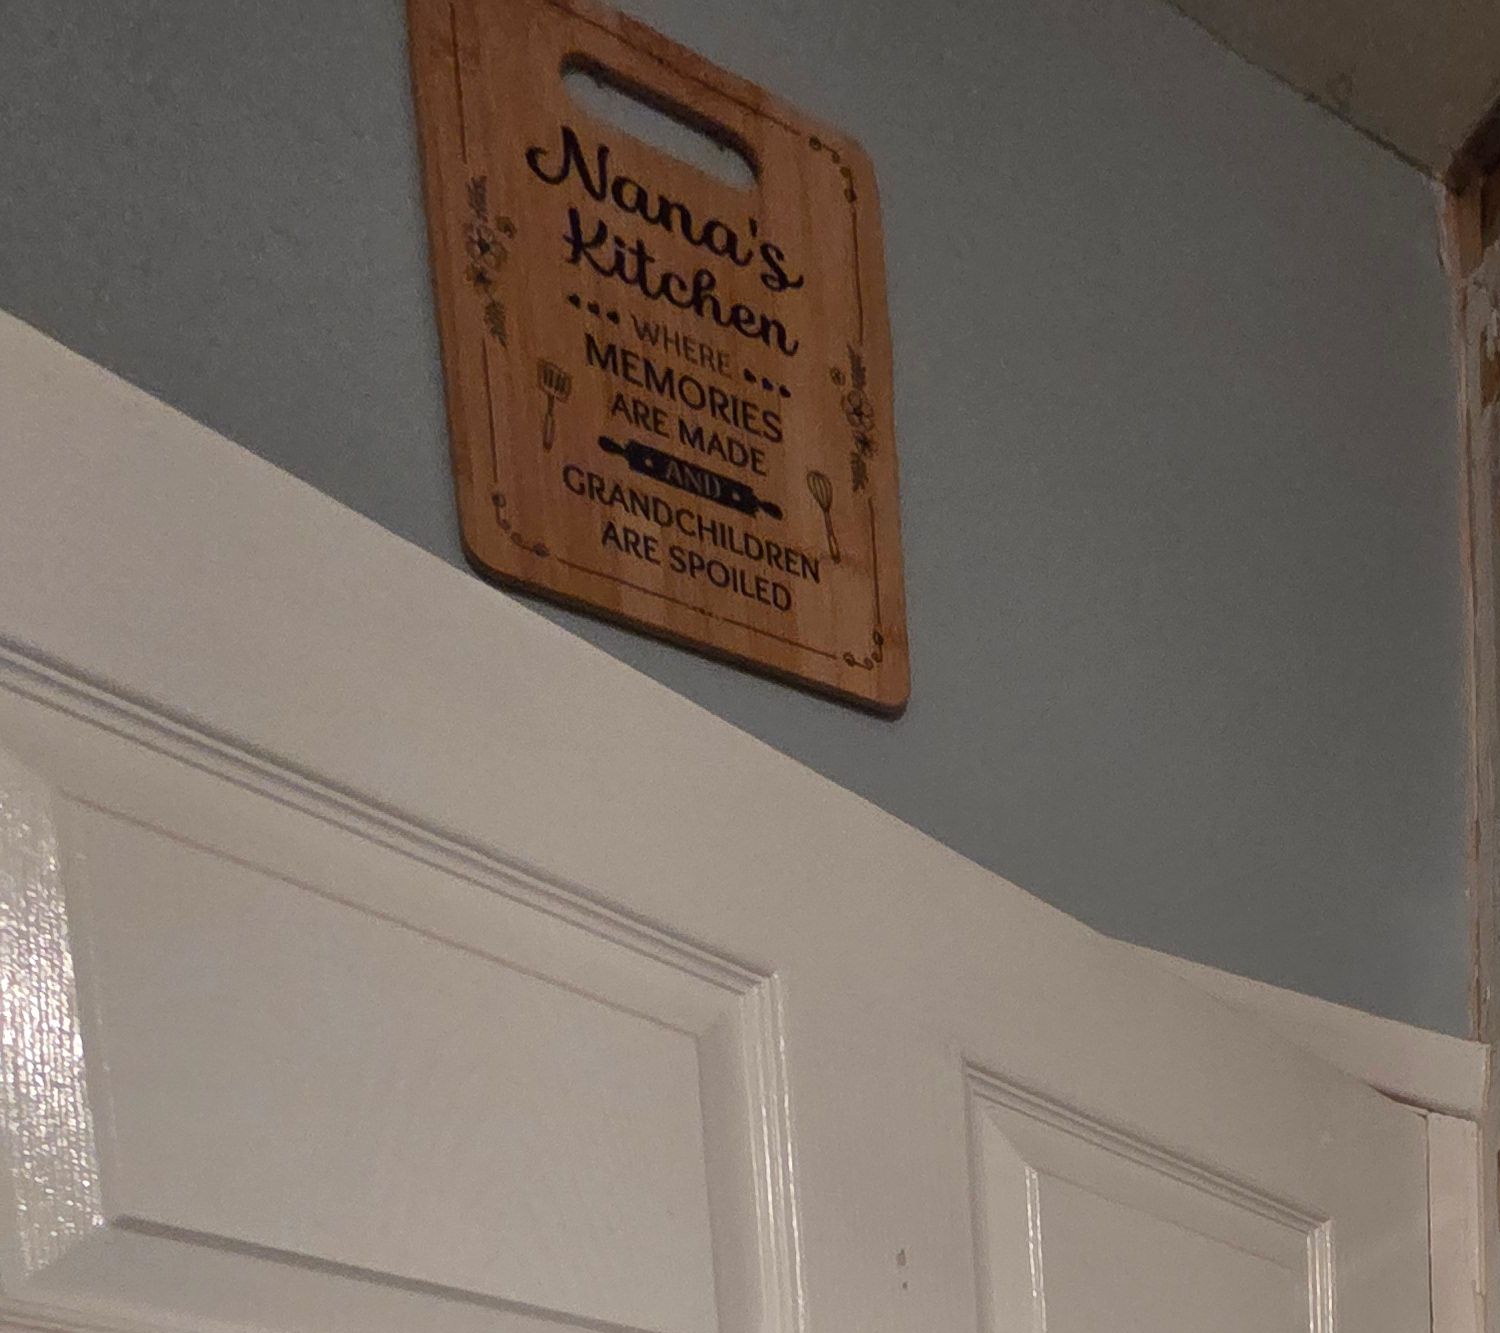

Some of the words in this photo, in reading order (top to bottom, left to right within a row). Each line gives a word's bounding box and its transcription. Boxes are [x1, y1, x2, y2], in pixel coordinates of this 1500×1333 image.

[525, 125, 804, 290] Nana's
[565, 207, 799, 357] Kitchen
[584, 332, 784, 443] MEMORIES
[632, 313, 733, 377] WHERE
[611, 392, 671, 440] ARE
[678, 416, 767, 475] MADE
[664, 457, 723, 499] AND
[562, 464, 821, 583] GRANDCHILDREN
[601, 518, 662, 565] ARE
[669, 545, 793, 612] SPOILED
